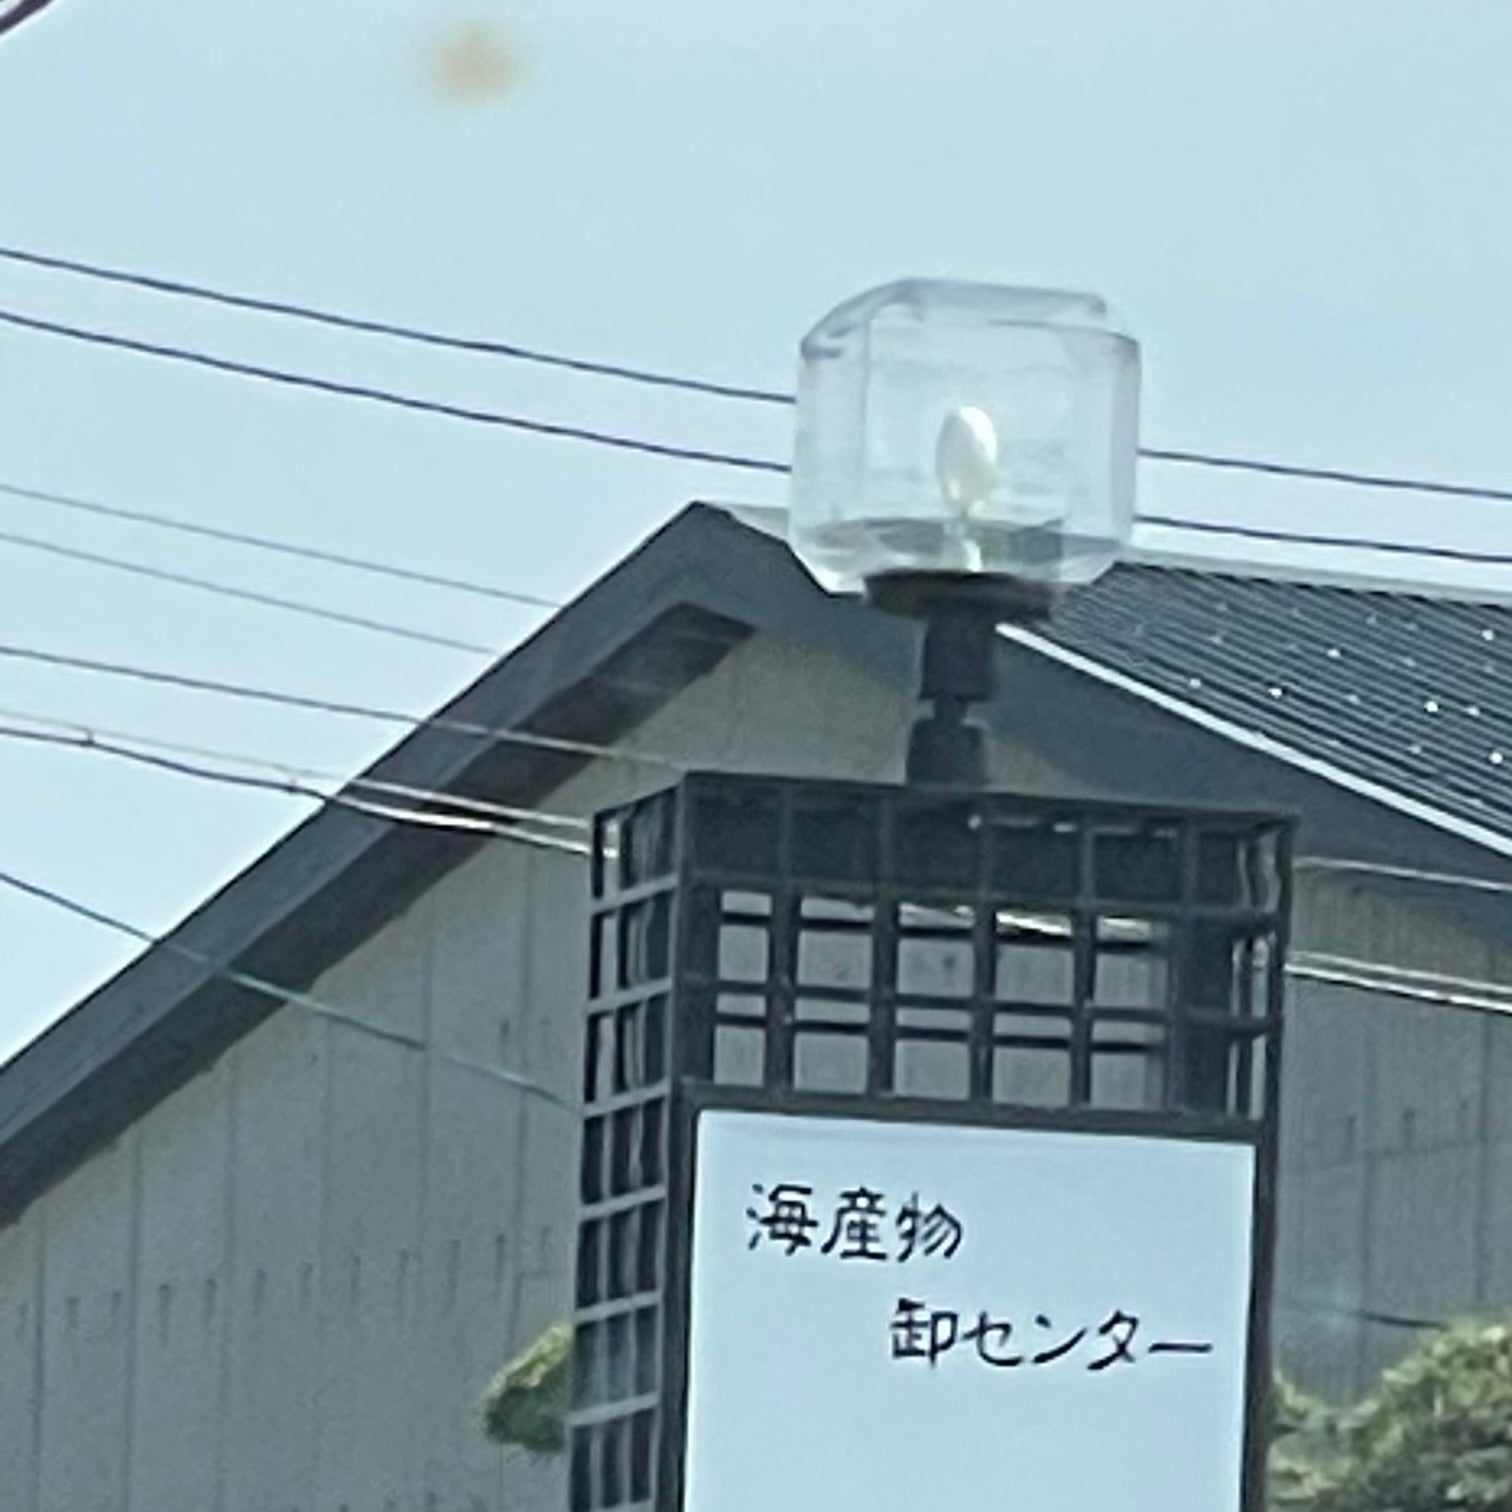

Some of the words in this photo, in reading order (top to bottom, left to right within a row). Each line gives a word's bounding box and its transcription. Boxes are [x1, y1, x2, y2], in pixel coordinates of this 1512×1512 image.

[746, 1182, 963, 1262] 海産物
[889, 1296, 1213, 1371] 卸センター
